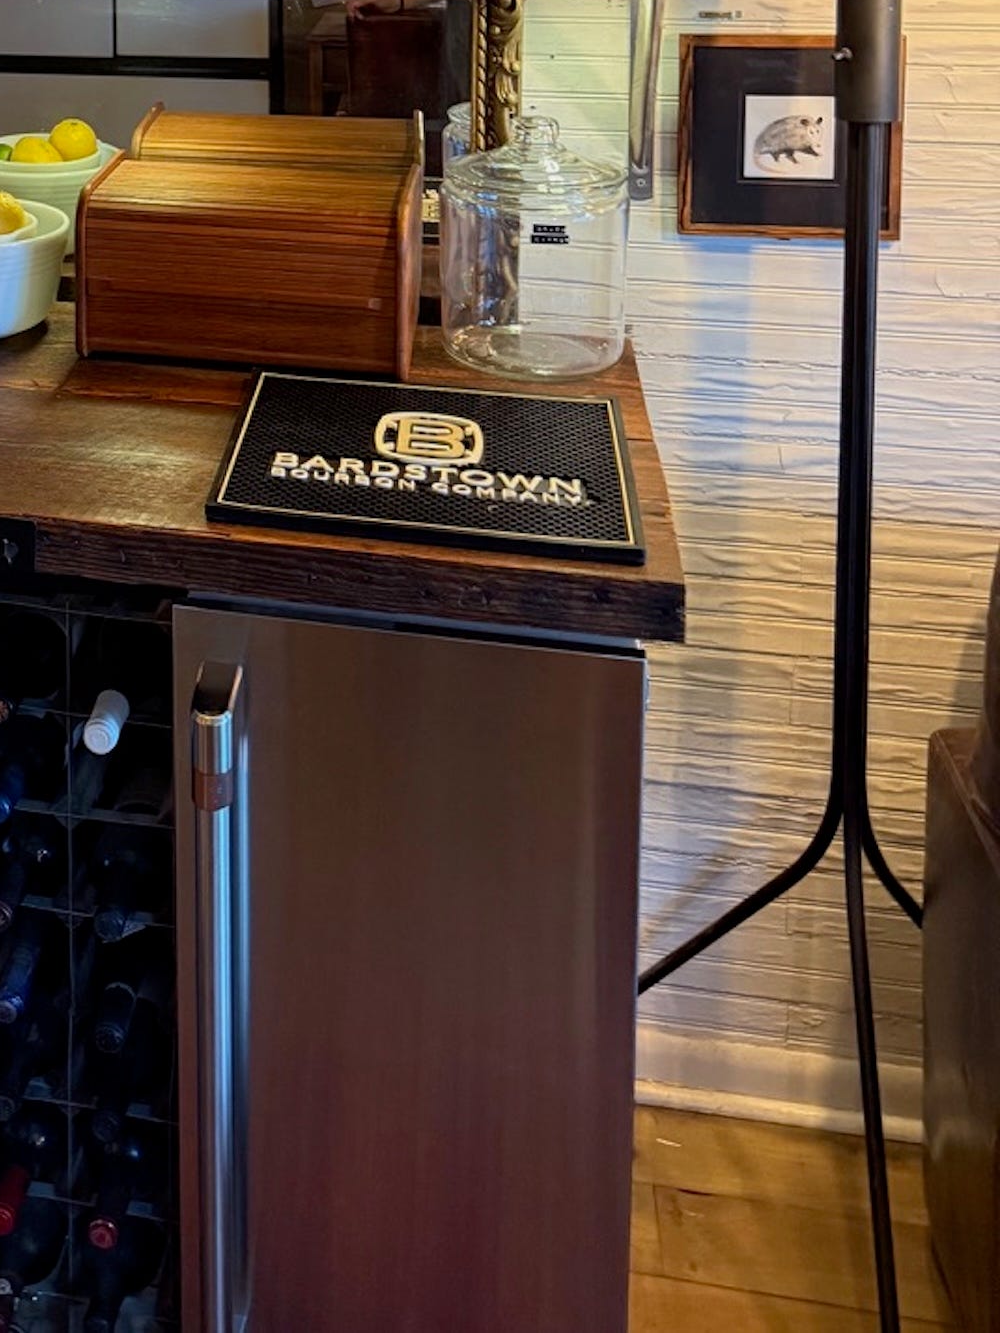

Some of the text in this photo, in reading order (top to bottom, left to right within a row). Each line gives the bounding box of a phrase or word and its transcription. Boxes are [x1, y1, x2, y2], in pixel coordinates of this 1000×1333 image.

[270, 466, 583, 507] BOURBON COMPANY
[272, 451, 583, 496] BARDSTOWN
